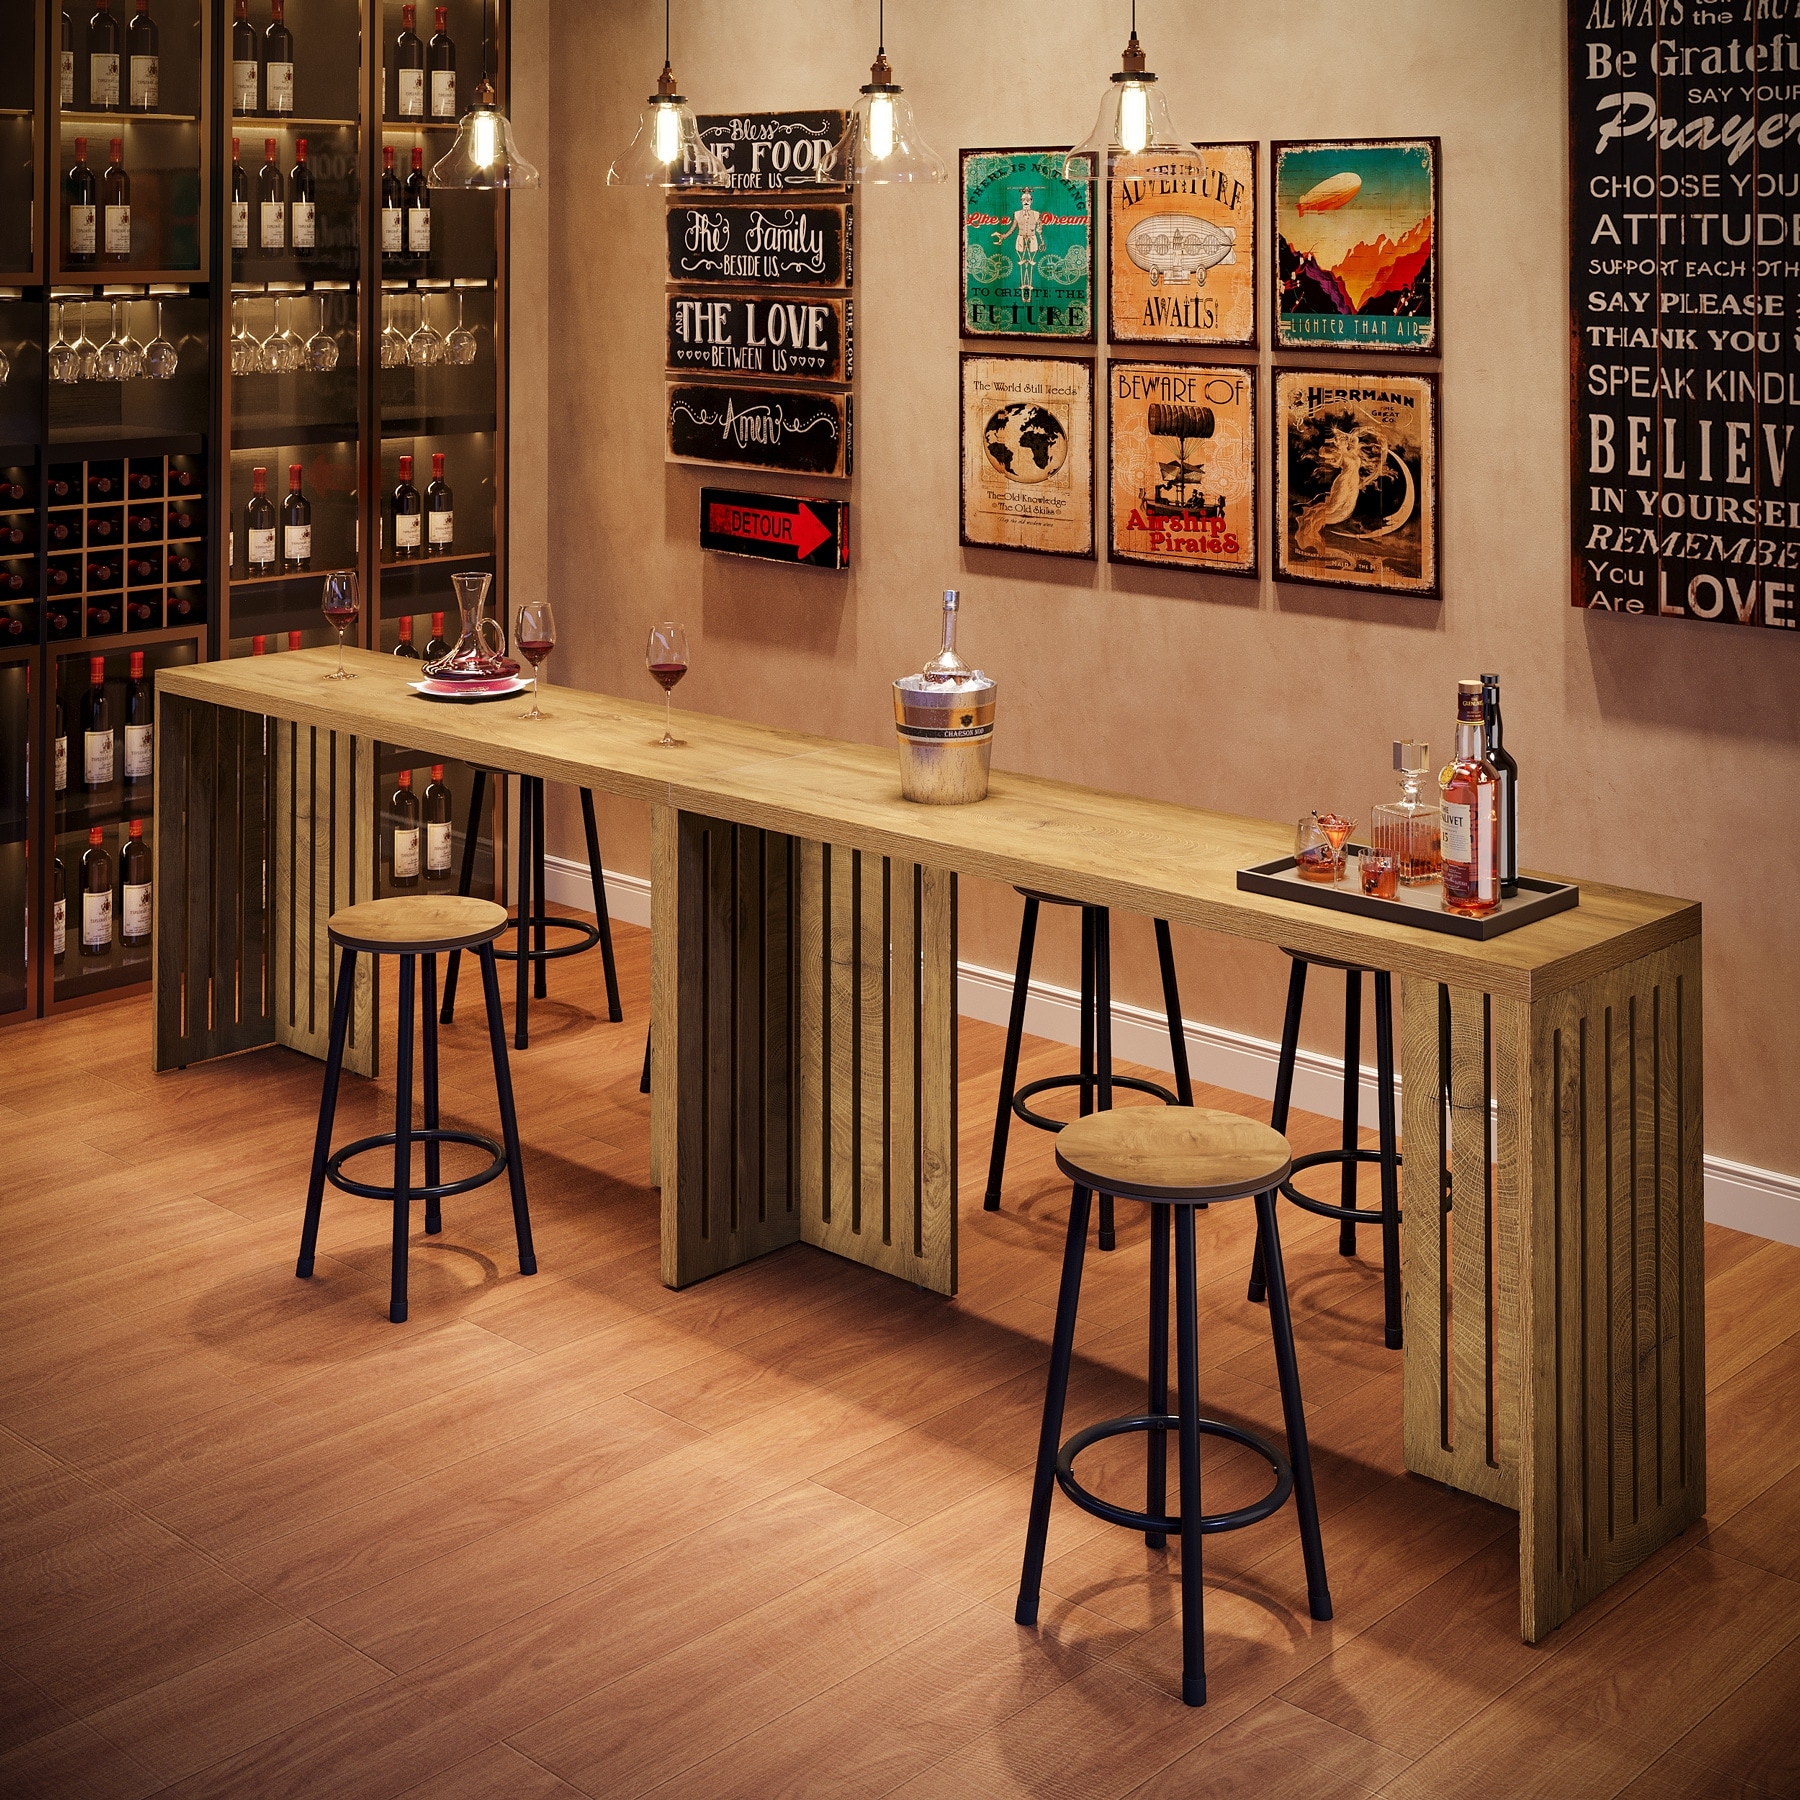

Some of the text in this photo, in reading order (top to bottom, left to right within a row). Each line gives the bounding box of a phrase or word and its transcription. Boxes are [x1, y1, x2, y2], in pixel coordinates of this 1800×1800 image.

[1692, 10, 1733, 25] the
[1585, 42, 1637, 80] Be
[1688, 88, 1733, 104] SAY
[729, 119, 779, 141] Bless
[682, 143, 736, 175] THE
[751, 139, 838, 174] FOOD
[725, 173, 762, 188] BEFORE
[1010, 163, 1026, 173] IS
[1031, 163, 1086, 211] NOTHING
[1590, 174, 1720, 198] CHOOSE
[966, 211, 999, 229] Like
[1040, 211, 1089, 226] Dream
[684, 210, 823, 267] The Family
[723, 254, 780, 277] BESIDE US,
[1588, 259, 1679, 276] SUPPORT
[1685, 260, 1746, 277] EACH
[972, 287, 990, 297] TO
[1054, 289, 1085, 299] THE
[1588, 291, 1650, 312] SAY
[1660, 293, 1785, 316] PLEASE
[675, 311, 684, 335] AND
[676, 301, 830, 351] THE LOVE
[971, 302, 1084, 327] FUTURE
[1291, 318, 1418, 337] LIGHTER THAN AIR
[1586, 326, 1698, 350] THANK
[1707, 330, 1780, 353] YOU
[711, 345, 788, 371] BETWEEN US
[973, 381, 991, 391] The
[993, 382, 1021, 393] World
[1023, 382, 1043, 394] Still
[1119, 374, 1244, 405] BEWARE OF
[1588, 364, 1696, 400] SPEAK
[1307, 386, 1415, 419] HERRMANN
[997, 503, 1013, 512] The
[1014, 503, 1031, 514] Old
[1004, 492, 1020, 502] Old
[1022, 494, 1066, 509] Knowledge
[1590, 486, 1627, 514] IN
[731, 511, 793, 540] DETOUR
[1126, 508, 1227, 538] Airship
[1588, 559, 1644, 586] You
[1588, 590, 1645, 614] Are
